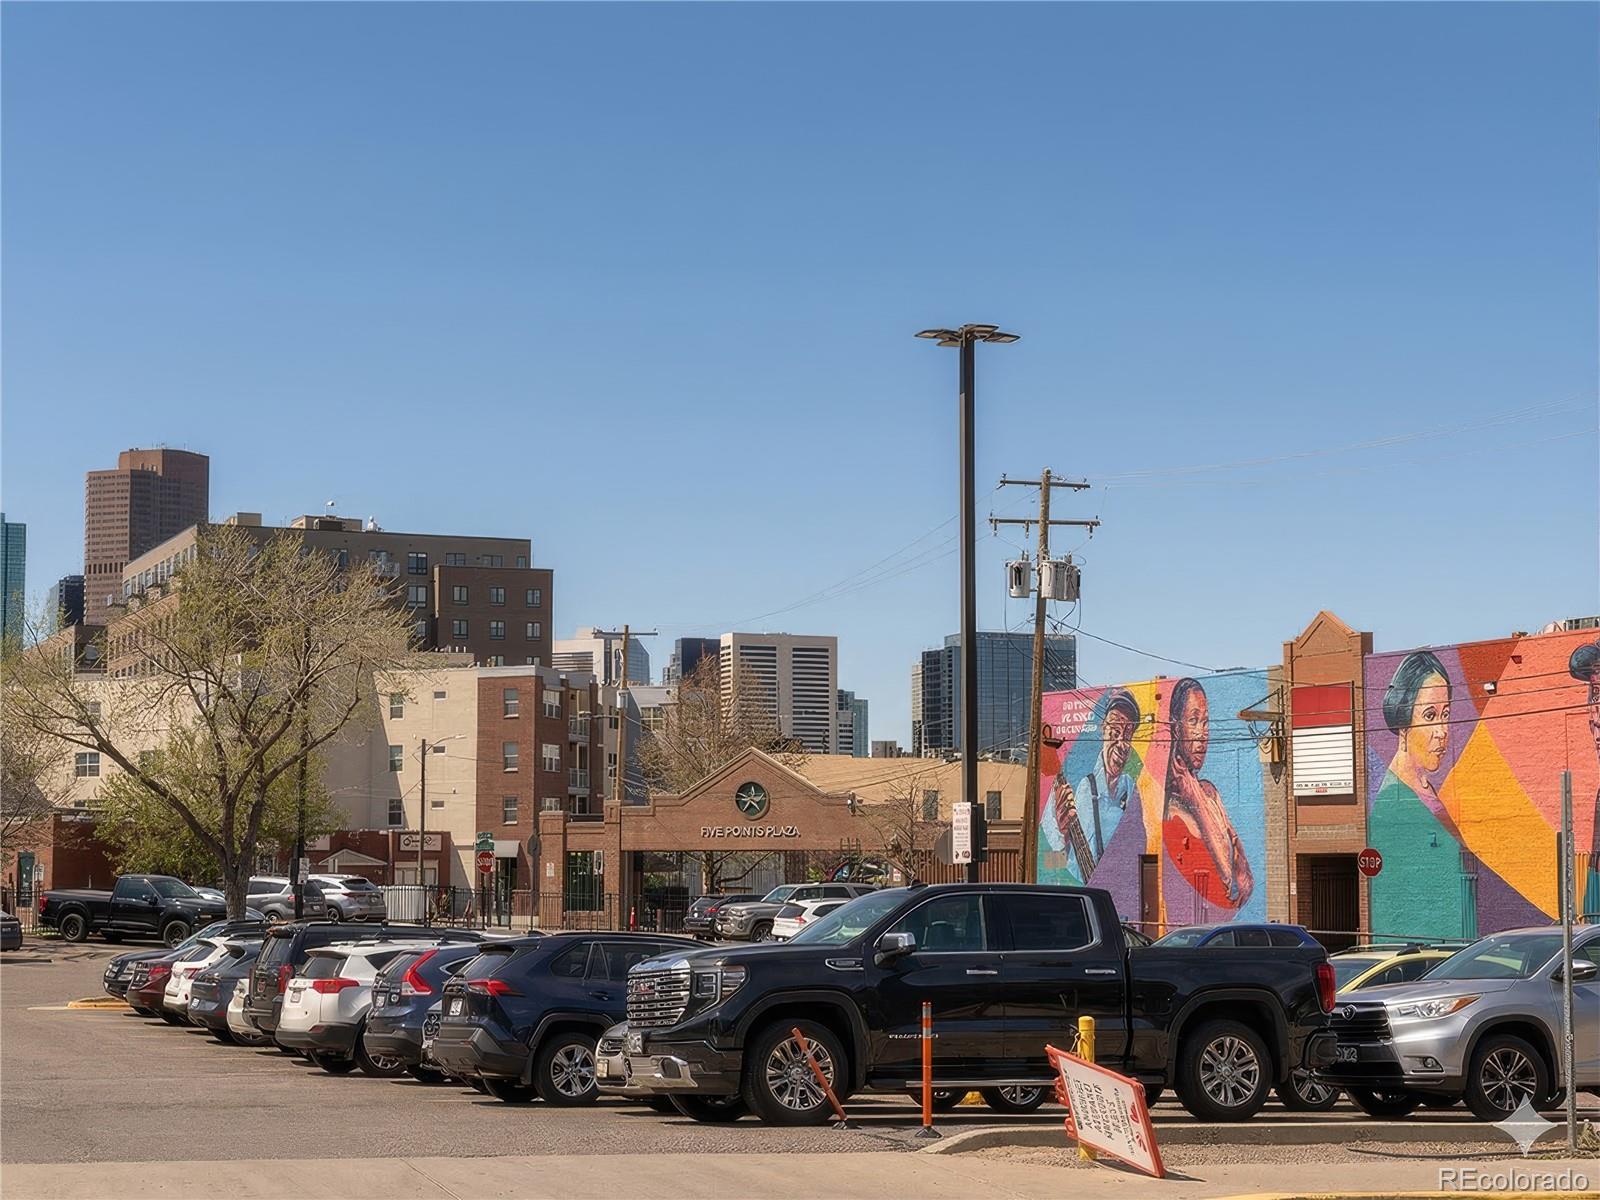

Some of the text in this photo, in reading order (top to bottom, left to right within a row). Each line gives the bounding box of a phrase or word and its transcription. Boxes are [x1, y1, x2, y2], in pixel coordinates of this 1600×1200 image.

[700, 825, 801, 838] FIVE POINTS PLAZA
[1360, 857, 1381, 868] STOP
